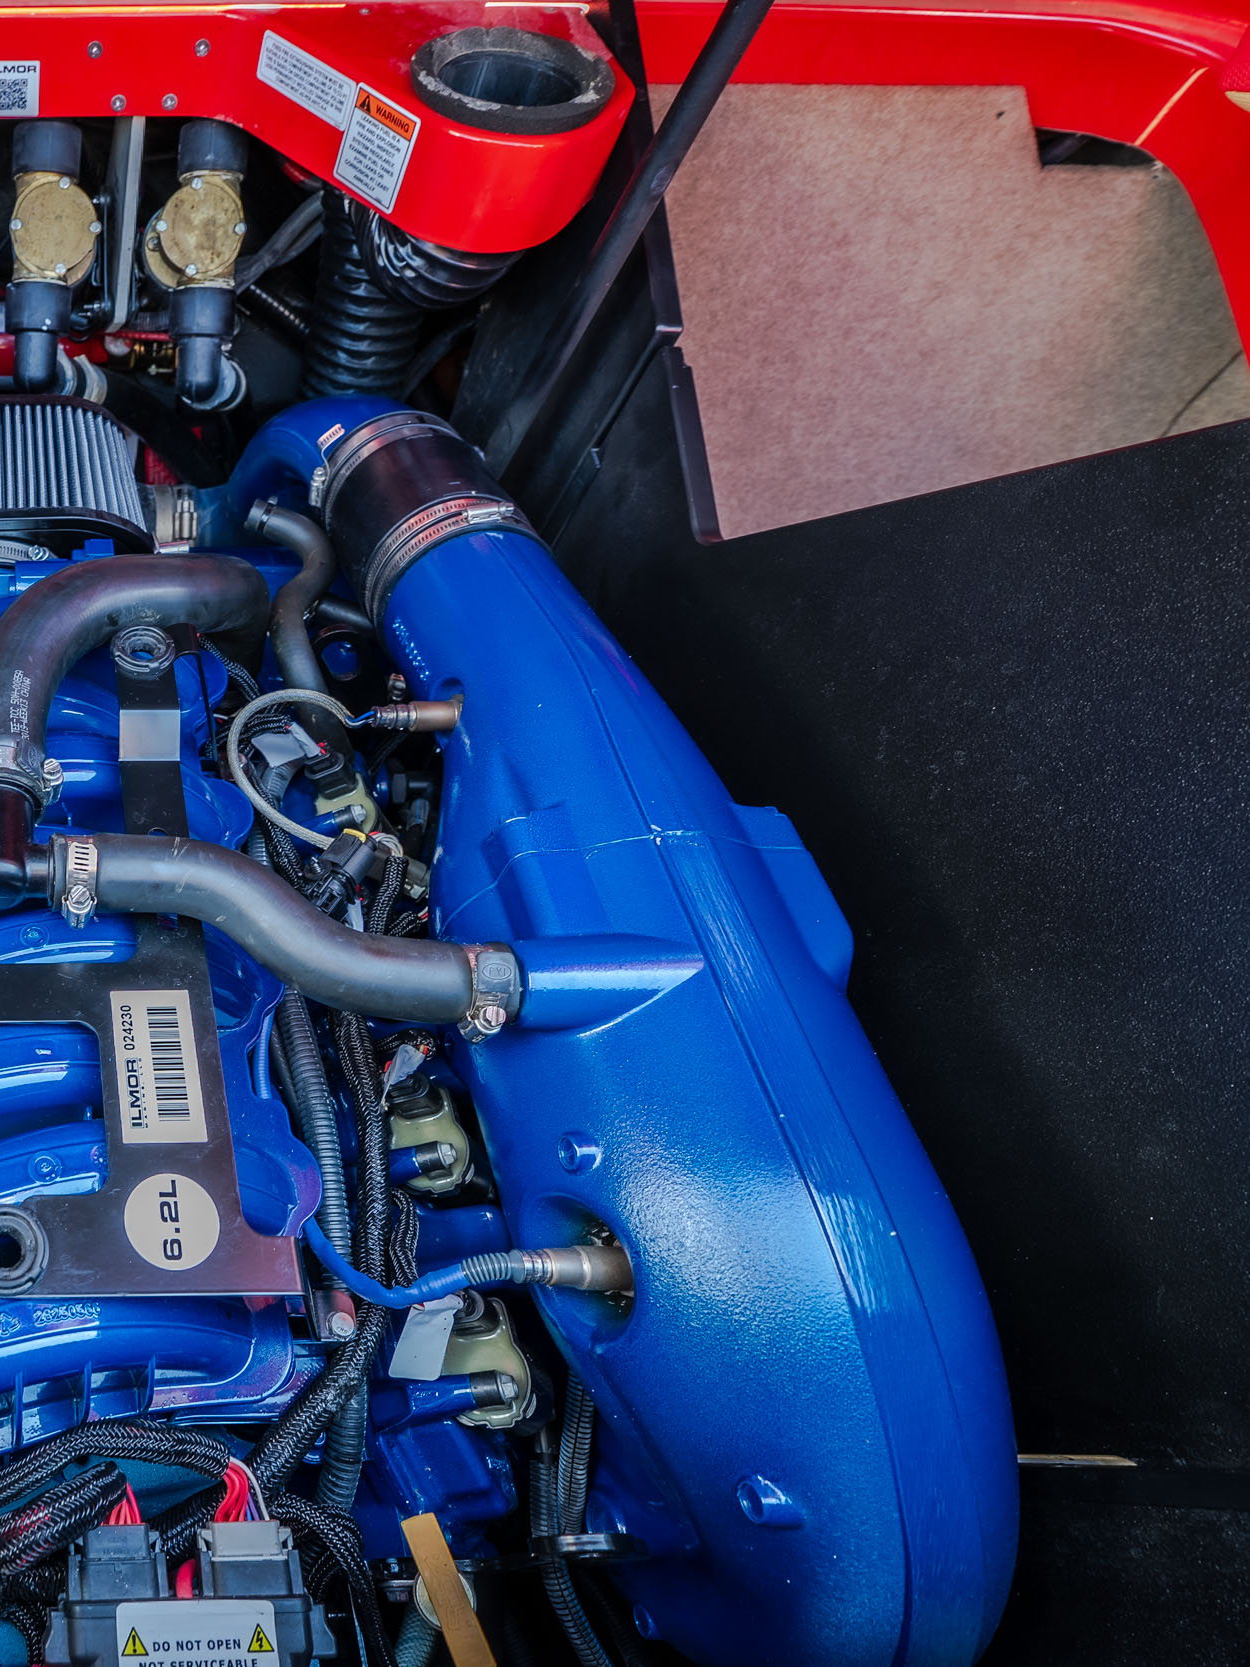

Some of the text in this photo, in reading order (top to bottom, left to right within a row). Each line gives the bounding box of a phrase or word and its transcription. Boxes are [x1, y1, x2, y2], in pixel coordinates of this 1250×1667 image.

[360, 114, 379, 130] LEAKING
[379, 126, 390, 137] FUEL
[374, 104, 410, 133] WARNING
[352, 136, 369, 151] SYSTEM
[355, 120, 401, 153] FIRE AND EXPLOSION
[375, 142, 394, 159] INSPECT
[353, 155, 384, 179] FOR LEAKS OR
[367, 155, 378, 167] FUEL
[379, 163, 393, 177] TANKS
[369, 175, 375, 183] AT
[375, 179, 389, 192] LEAST
[20, 676, 31, 697] CHINA
[120, 1005, 143, 1128] ILMOR 024230
[158, 1179, 183, 1261] 6.2L
[153, 1638, 241, 1652] DO NOT OPEN
